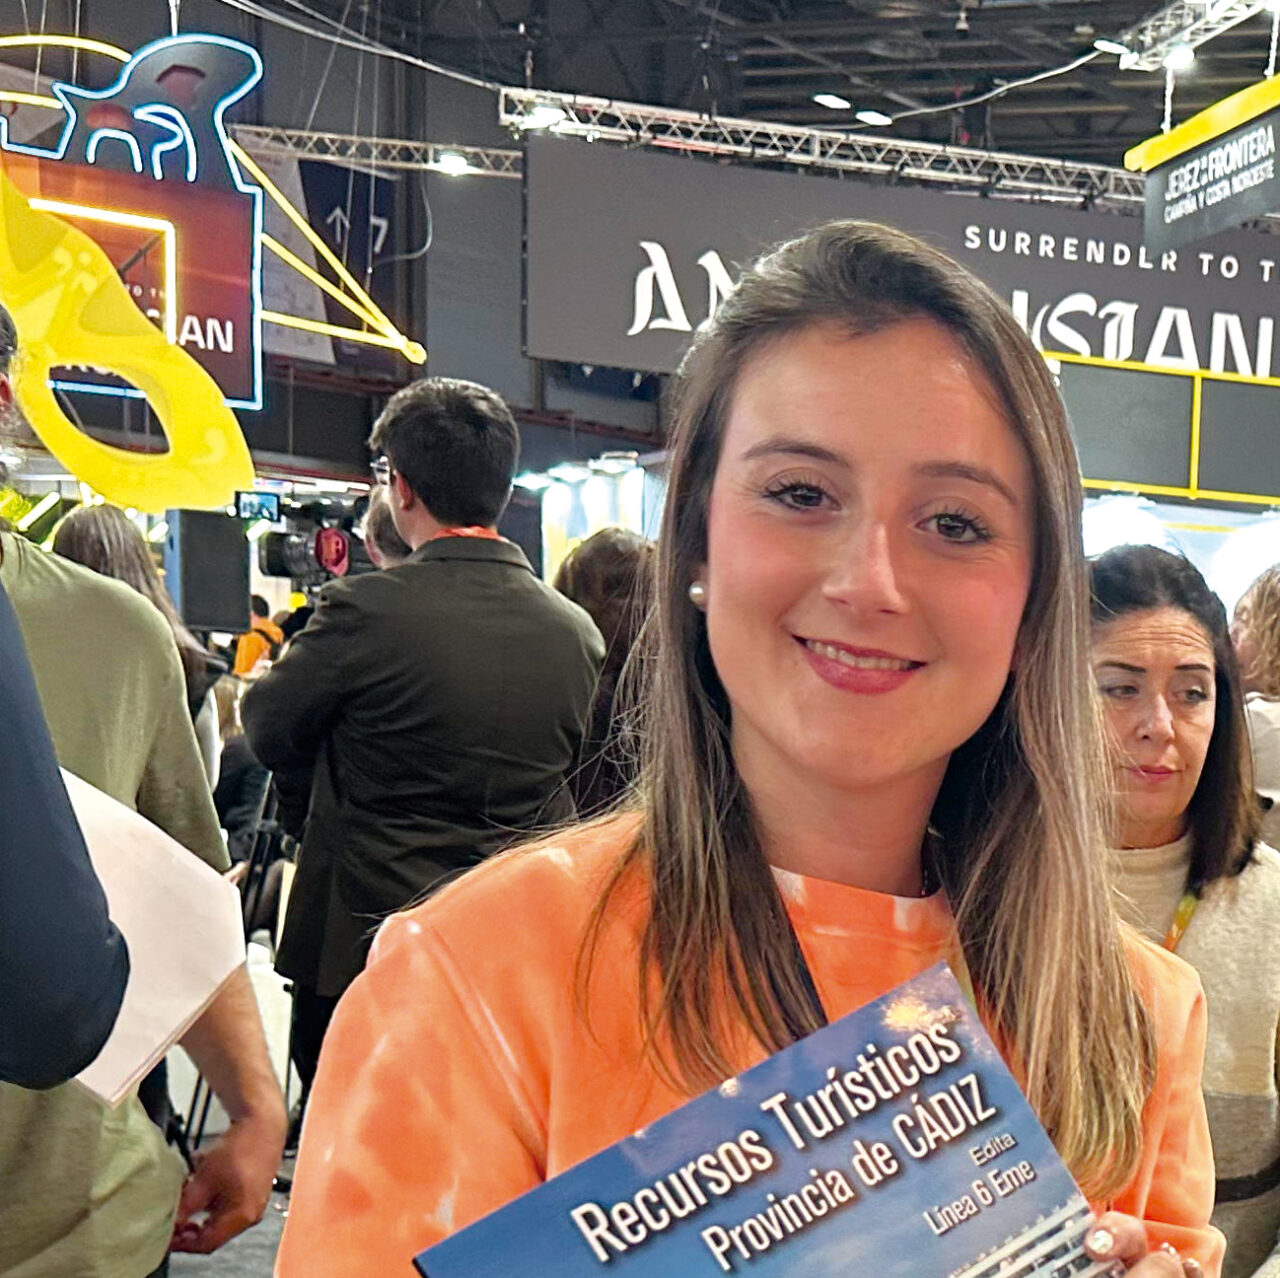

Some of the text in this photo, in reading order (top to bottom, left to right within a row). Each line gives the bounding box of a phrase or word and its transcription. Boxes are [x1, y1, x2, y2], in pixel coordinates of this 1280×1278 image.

[1164, 158, 1200, 201] JEREZ
[1208, 124, 1275, 181] FRONTERA
[1199, 252, 1240, 279] TO
[570, 1021, 963, 1264] Recursos Turísticos
[700, 1073, 998, 1273] Provincia de CÁDIZ
[968, 1131, 1018, 1167] Edita
[922, 1160, 1037, 1237] Línea 6 Eme
